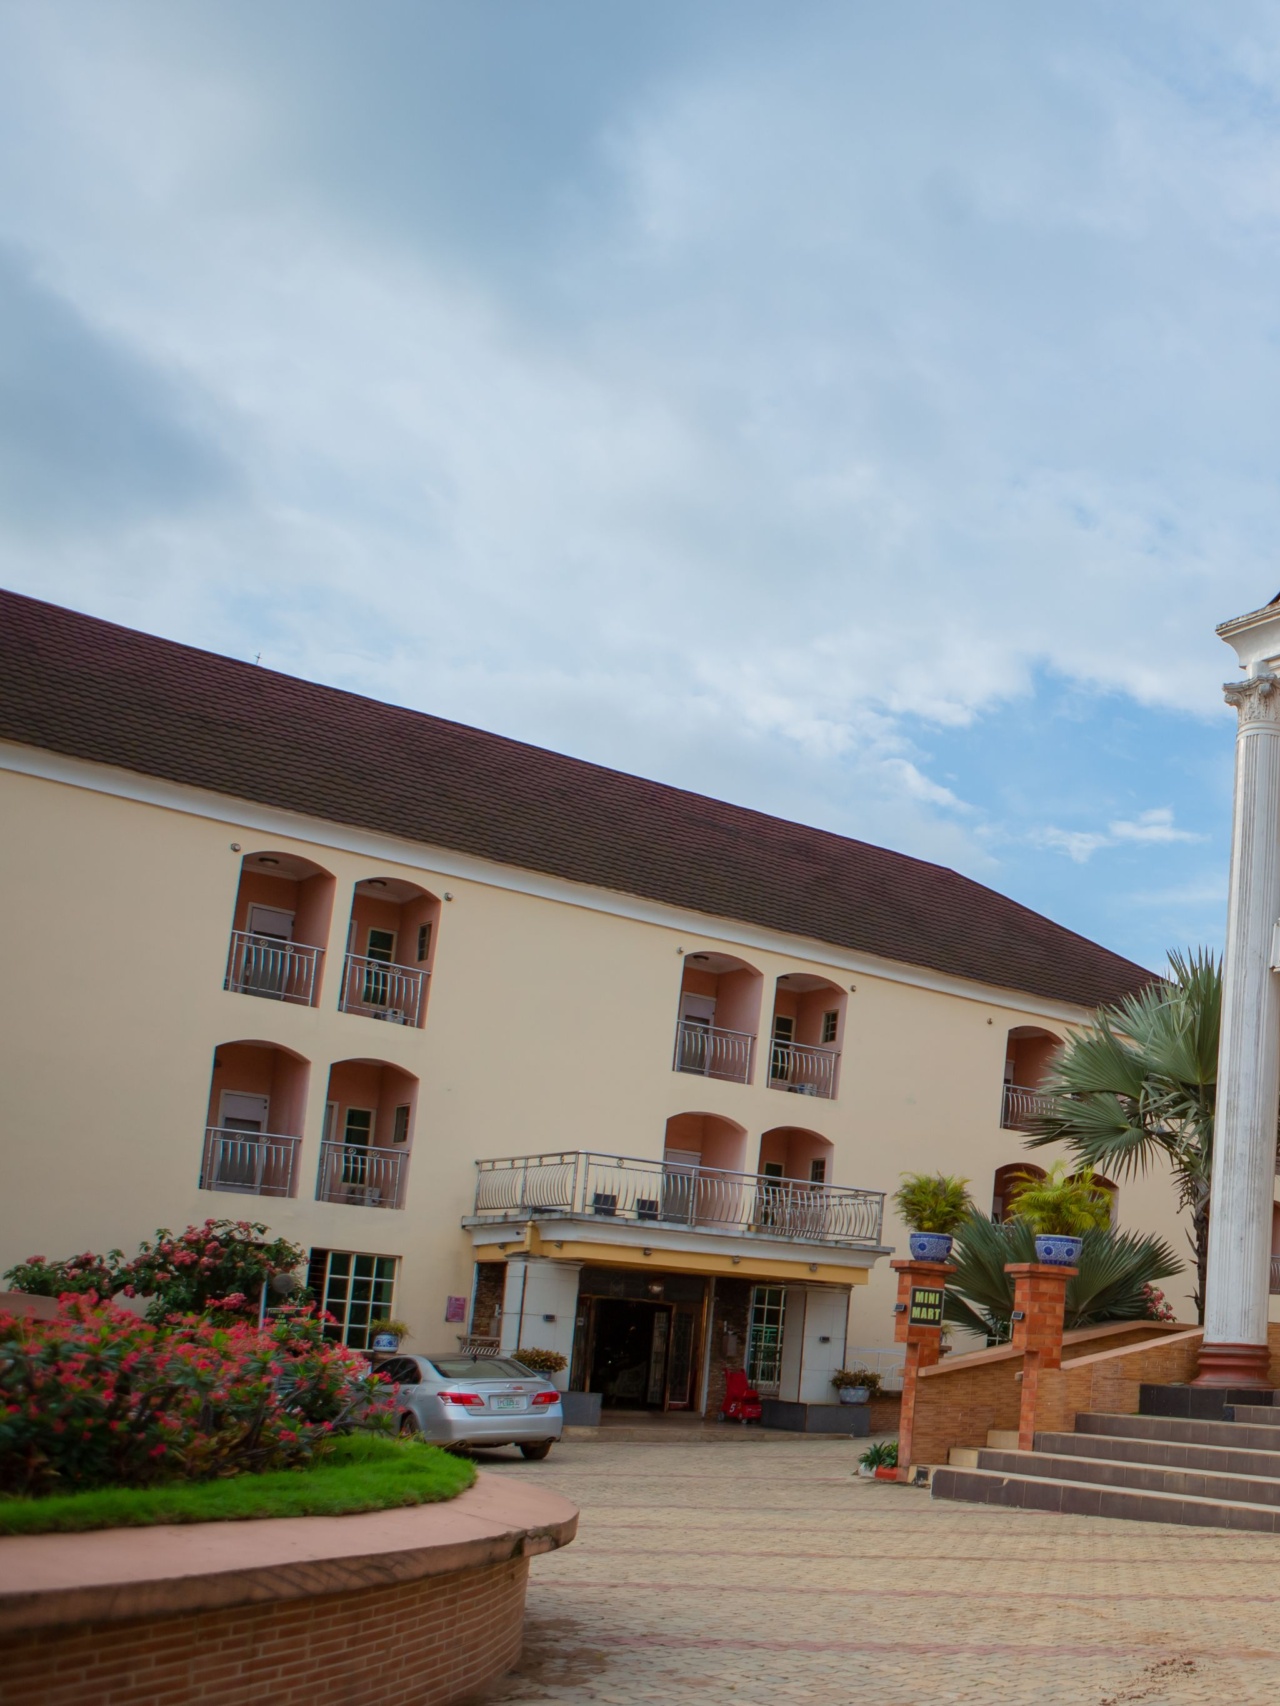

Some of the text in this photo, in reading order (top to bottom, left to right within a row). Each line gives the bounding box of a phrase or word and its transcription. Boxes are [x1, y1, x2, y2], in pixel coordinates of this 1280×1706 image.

[915, 1291, 940, 1305] MINI
[911, 1306, 941, 1320] MART
[729, 1403, 736, 1413] 5
